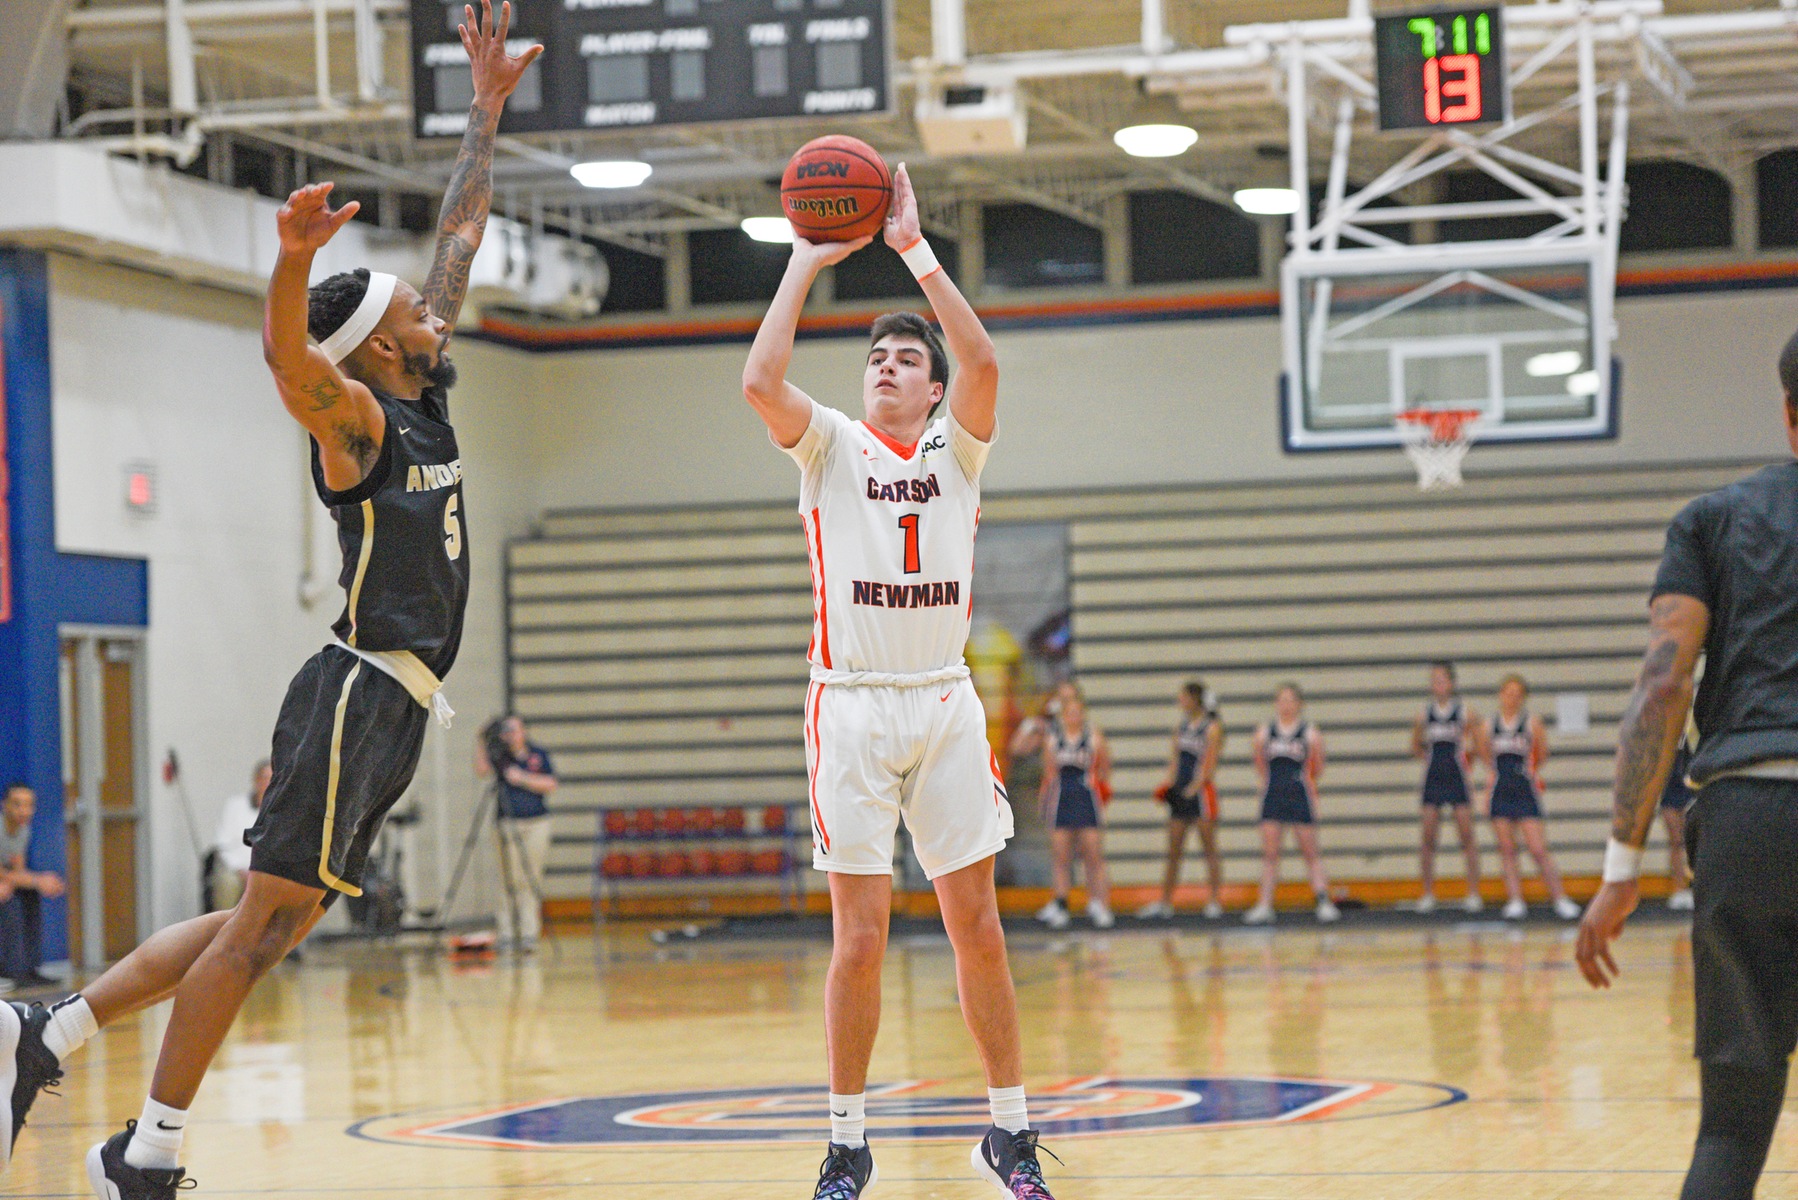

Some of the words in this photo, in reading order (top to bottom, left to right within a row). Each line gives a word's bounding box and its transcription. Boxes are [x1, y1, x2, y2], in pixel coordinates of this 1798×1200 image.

[1423, 54, 1482, 124] 13
[797, 161, 850, 180] NCAA
[788, 195, 860, 218] Wilson
[921, 435, 946, 458] AC
[866, 473, 941, 504] CARSON
[443, 493, 462, 561] 5
[898, 513, 921, 575] 1
[852, 580, 960, 609] NEWMAN
